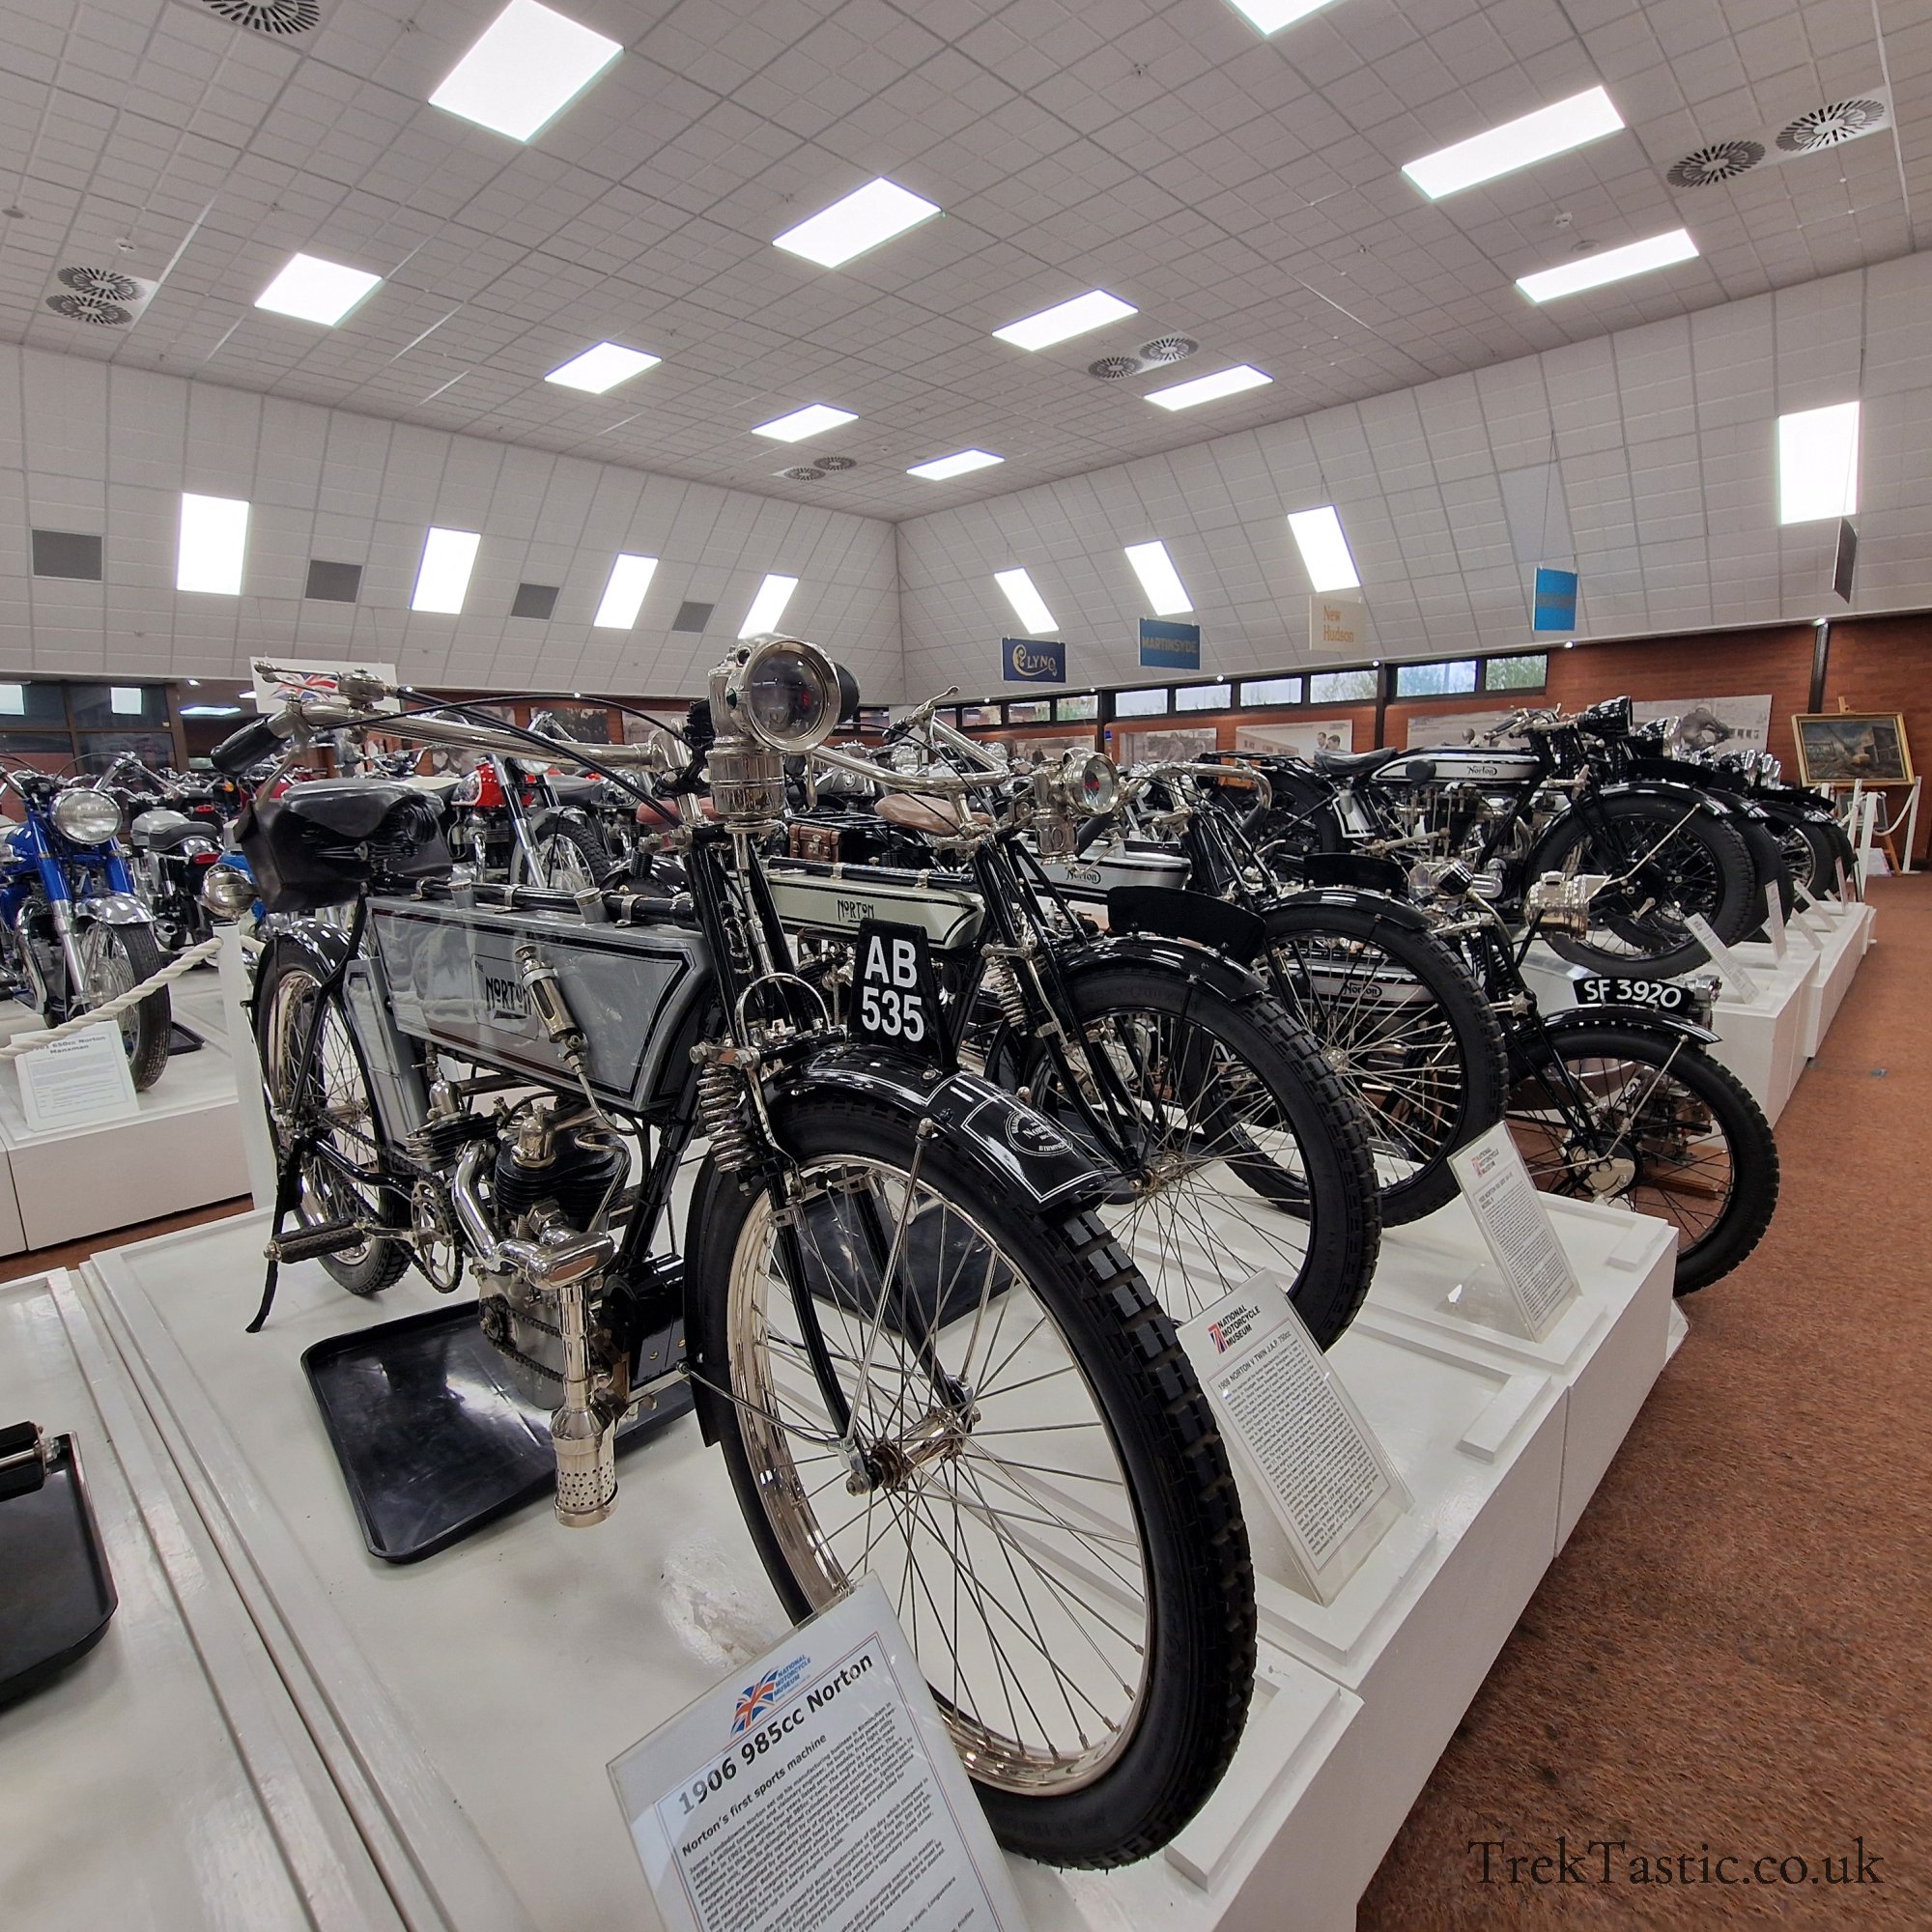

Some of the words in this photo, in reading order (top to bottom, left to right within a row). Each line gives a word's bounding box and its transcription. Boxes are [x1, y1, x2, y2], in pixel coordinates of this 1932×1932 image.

[1322, 624, 1354, 643] Hudson
[1466, 765, 1497, 776] Norton
[838, 899, 874, 921] NORTON
[865, 935, 917, 988] AB
[1584, 980, 1610, 1003] SF
[1616, 980, 1682, 1008] 3920
[862, 985, 924, 1042] 535
[1217, 1304, 1247, 1328] NATIONAL
[1222, 1305, 1261, 1338] MOTORCYCLE
[1226, 1323, 1253, 1347] MUSEUM
[1230, 1362, 1251, 1382] NORTON
[776, 1657, 811, 1688] MOTORCYCLE
[778, 1655, 805, 1678] NATIONAL
[774, 1673, 800, 1695] MUSEUM
[679, 1757, 737, 1814] 1906
[741, 1708, 805, 1766] 985cc
[807, 1655, 873, 1713] Norton
[681, 1811, 729, 1858] Norton's
[729, 1793, 753, 1818] first
[753, 1766, 786, 1801] sports
[785, 1732, 827, 1772] machine
